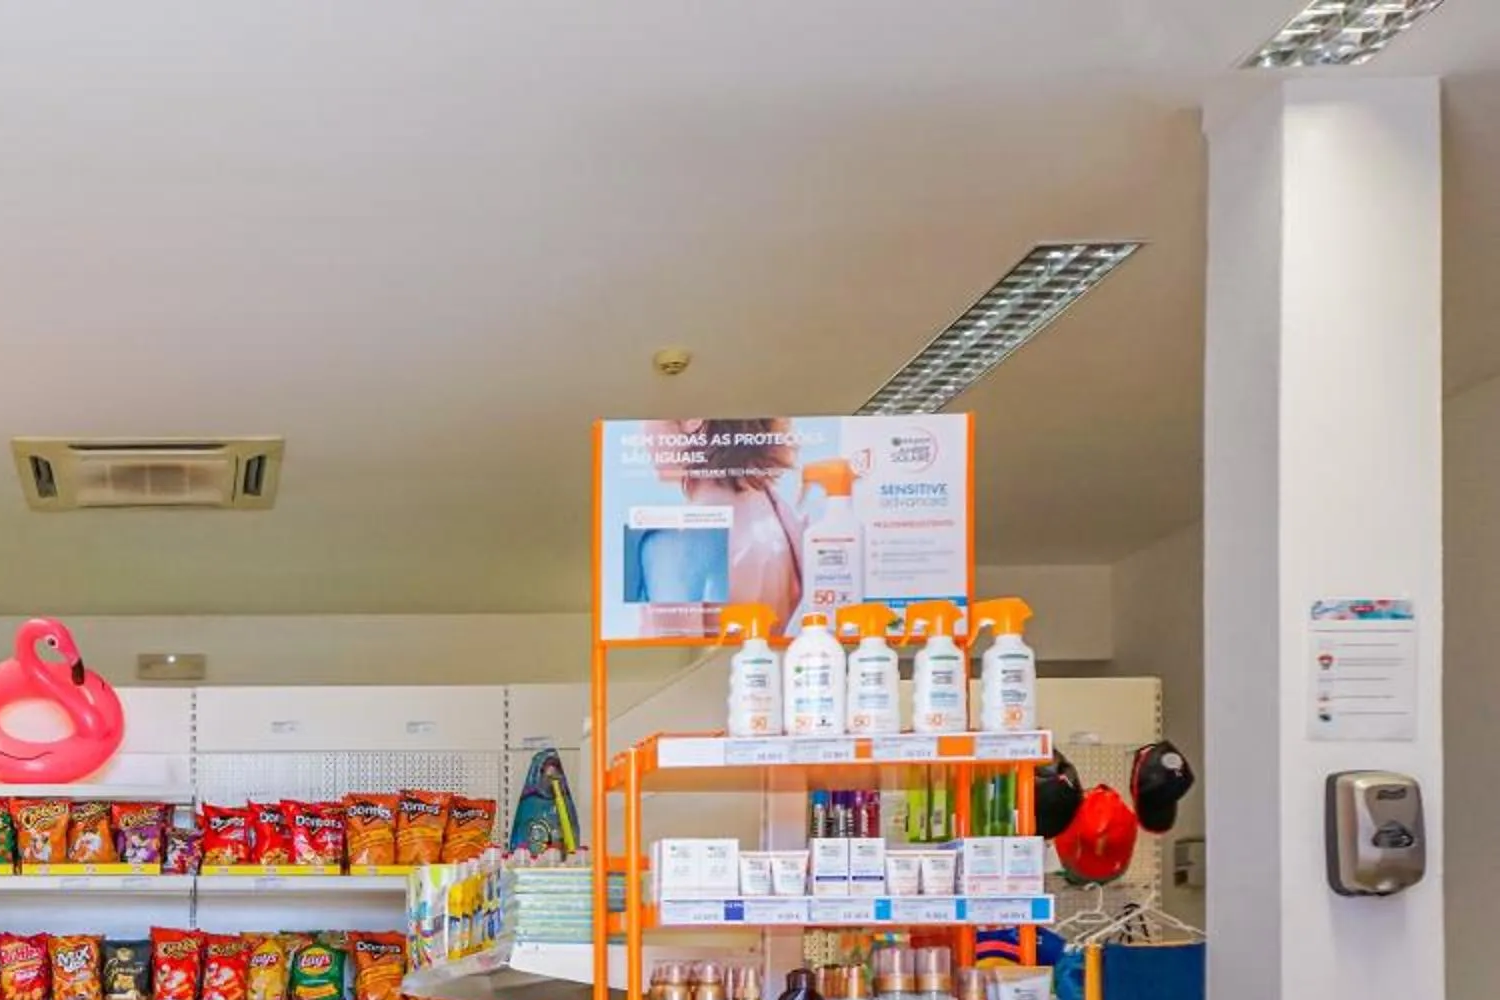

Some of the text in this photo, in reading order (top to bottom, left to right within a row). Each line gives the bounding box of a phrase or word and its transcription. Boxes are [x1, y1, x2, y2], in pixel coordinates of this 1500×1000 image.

[658, 433, 708, 447] TODAS
[710, 433, 732, 447] AS
[879, 483, 948, 496] SENSITIVE
